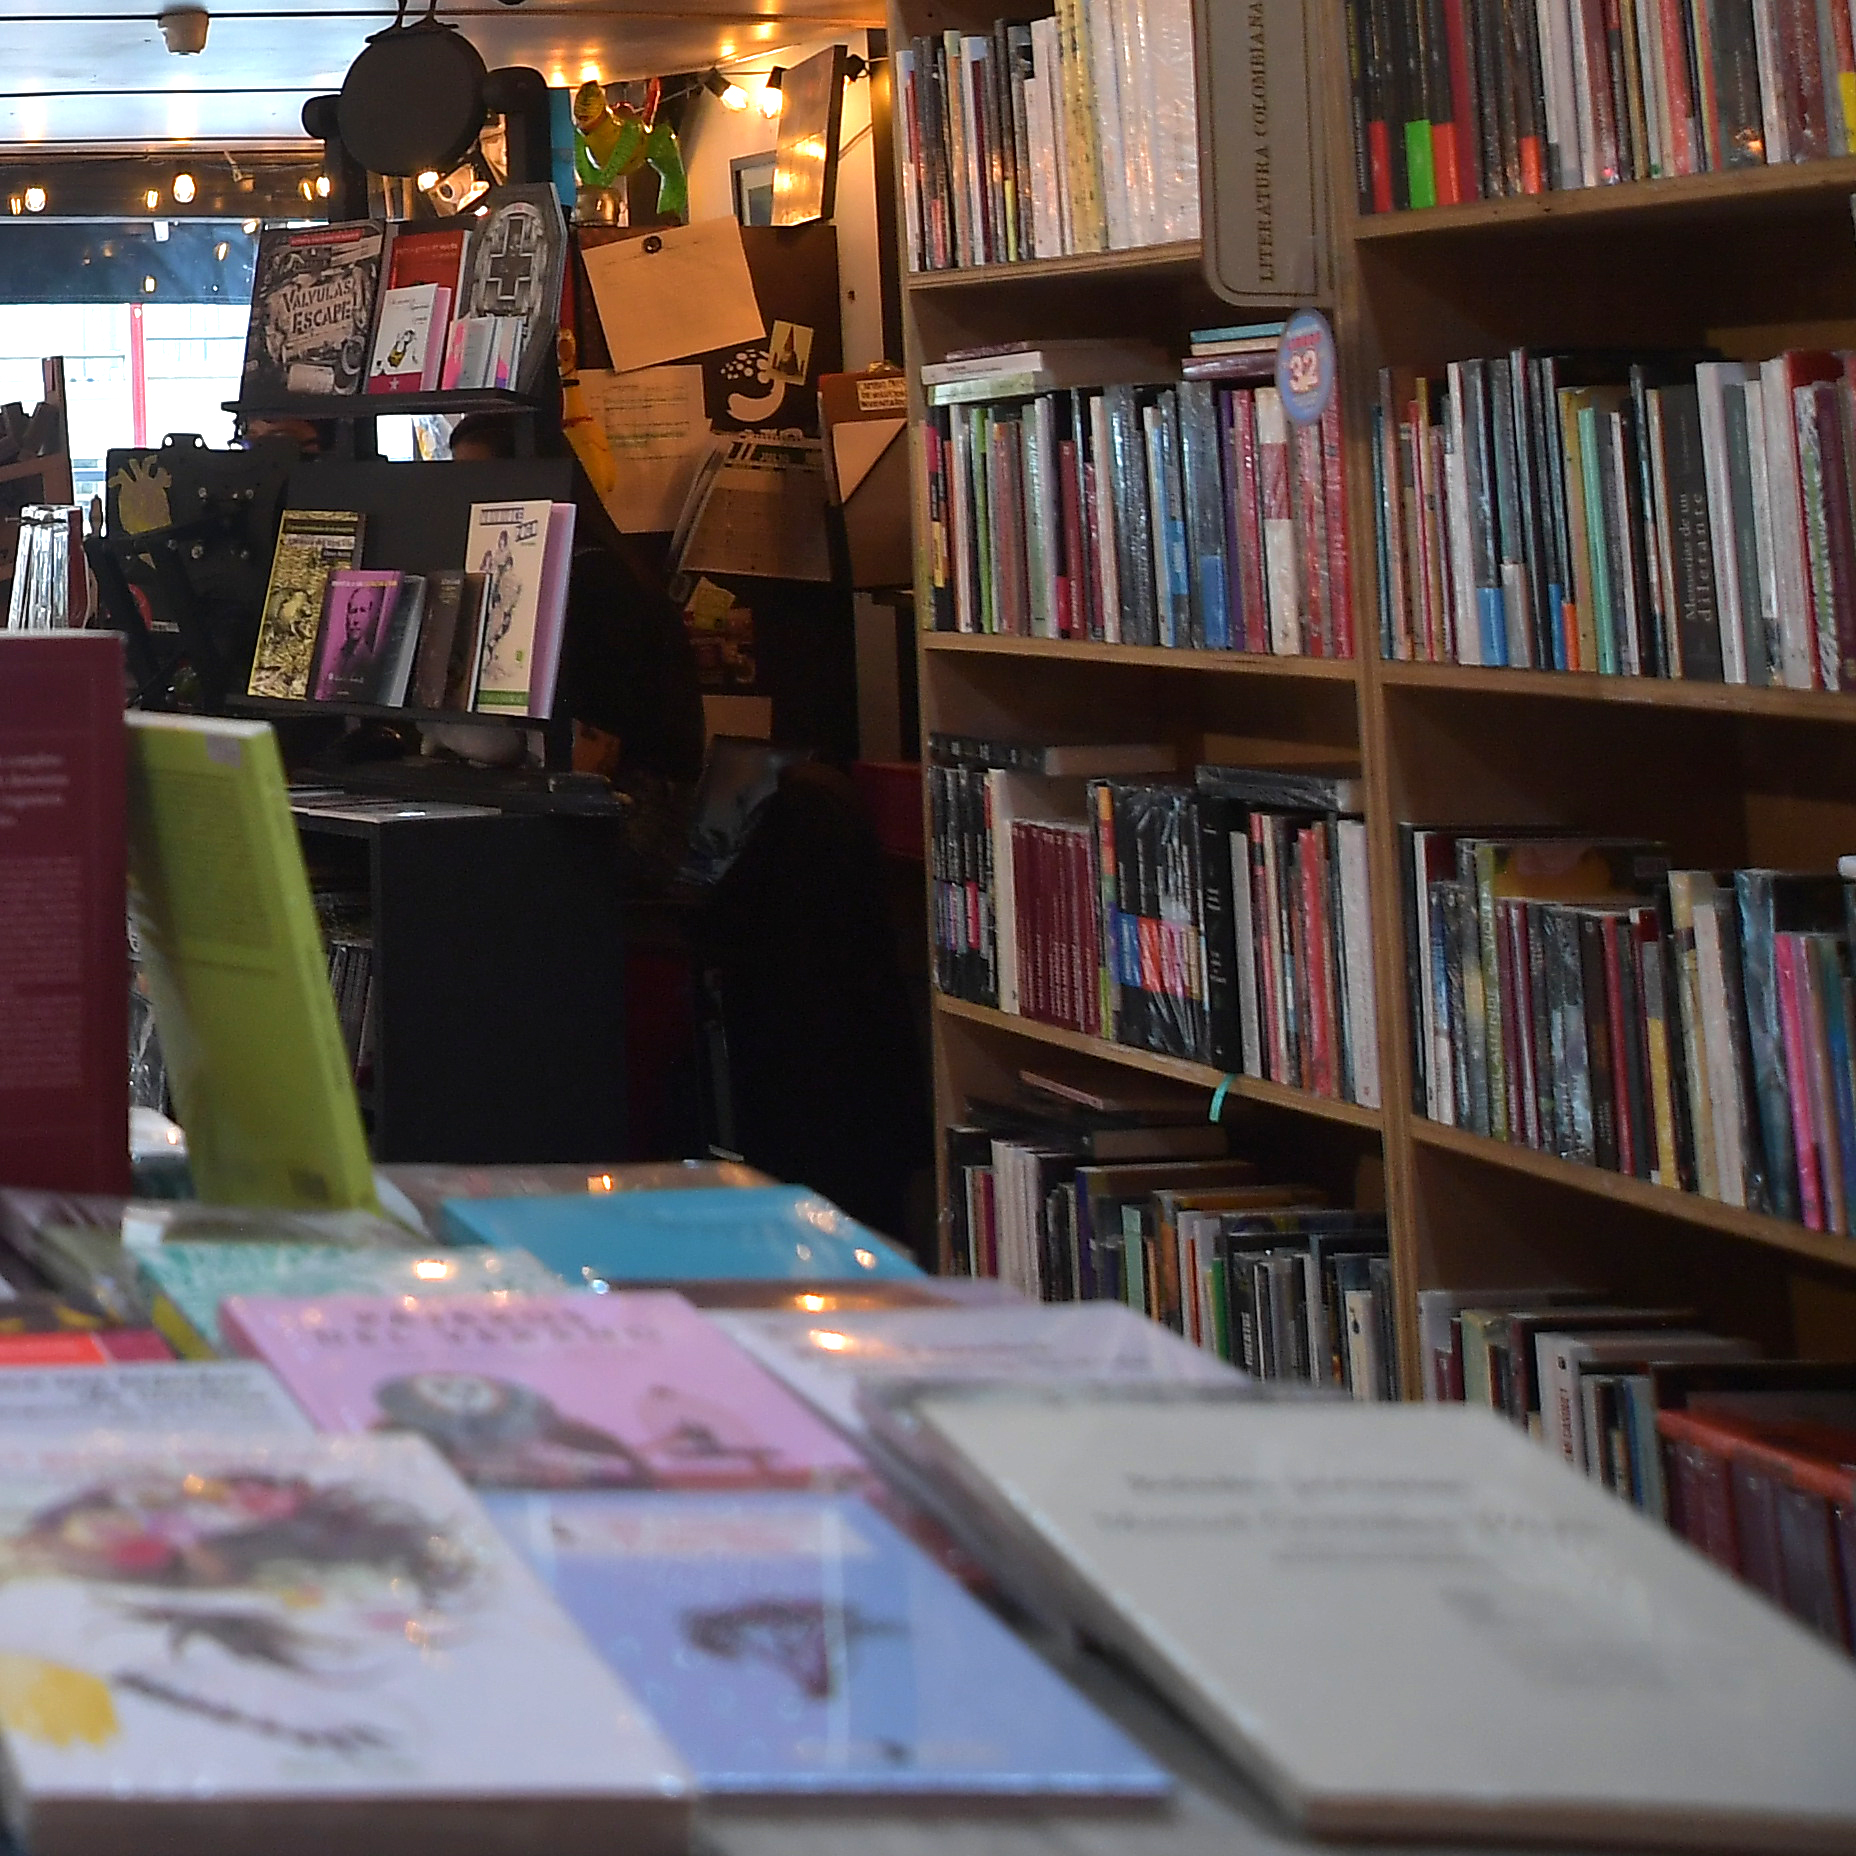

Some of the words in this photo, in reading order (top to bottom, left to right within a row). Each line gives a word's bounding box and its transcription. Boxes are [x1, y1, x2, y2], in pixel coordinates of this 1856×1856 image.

[1247, 0, 1267, 138] COLOMBIANA
[1255, 144, 1273, 284] LITERATURA
[291, 300, 353, 334] ESCAPE
[1691, 492, 1713, 623] diletante
